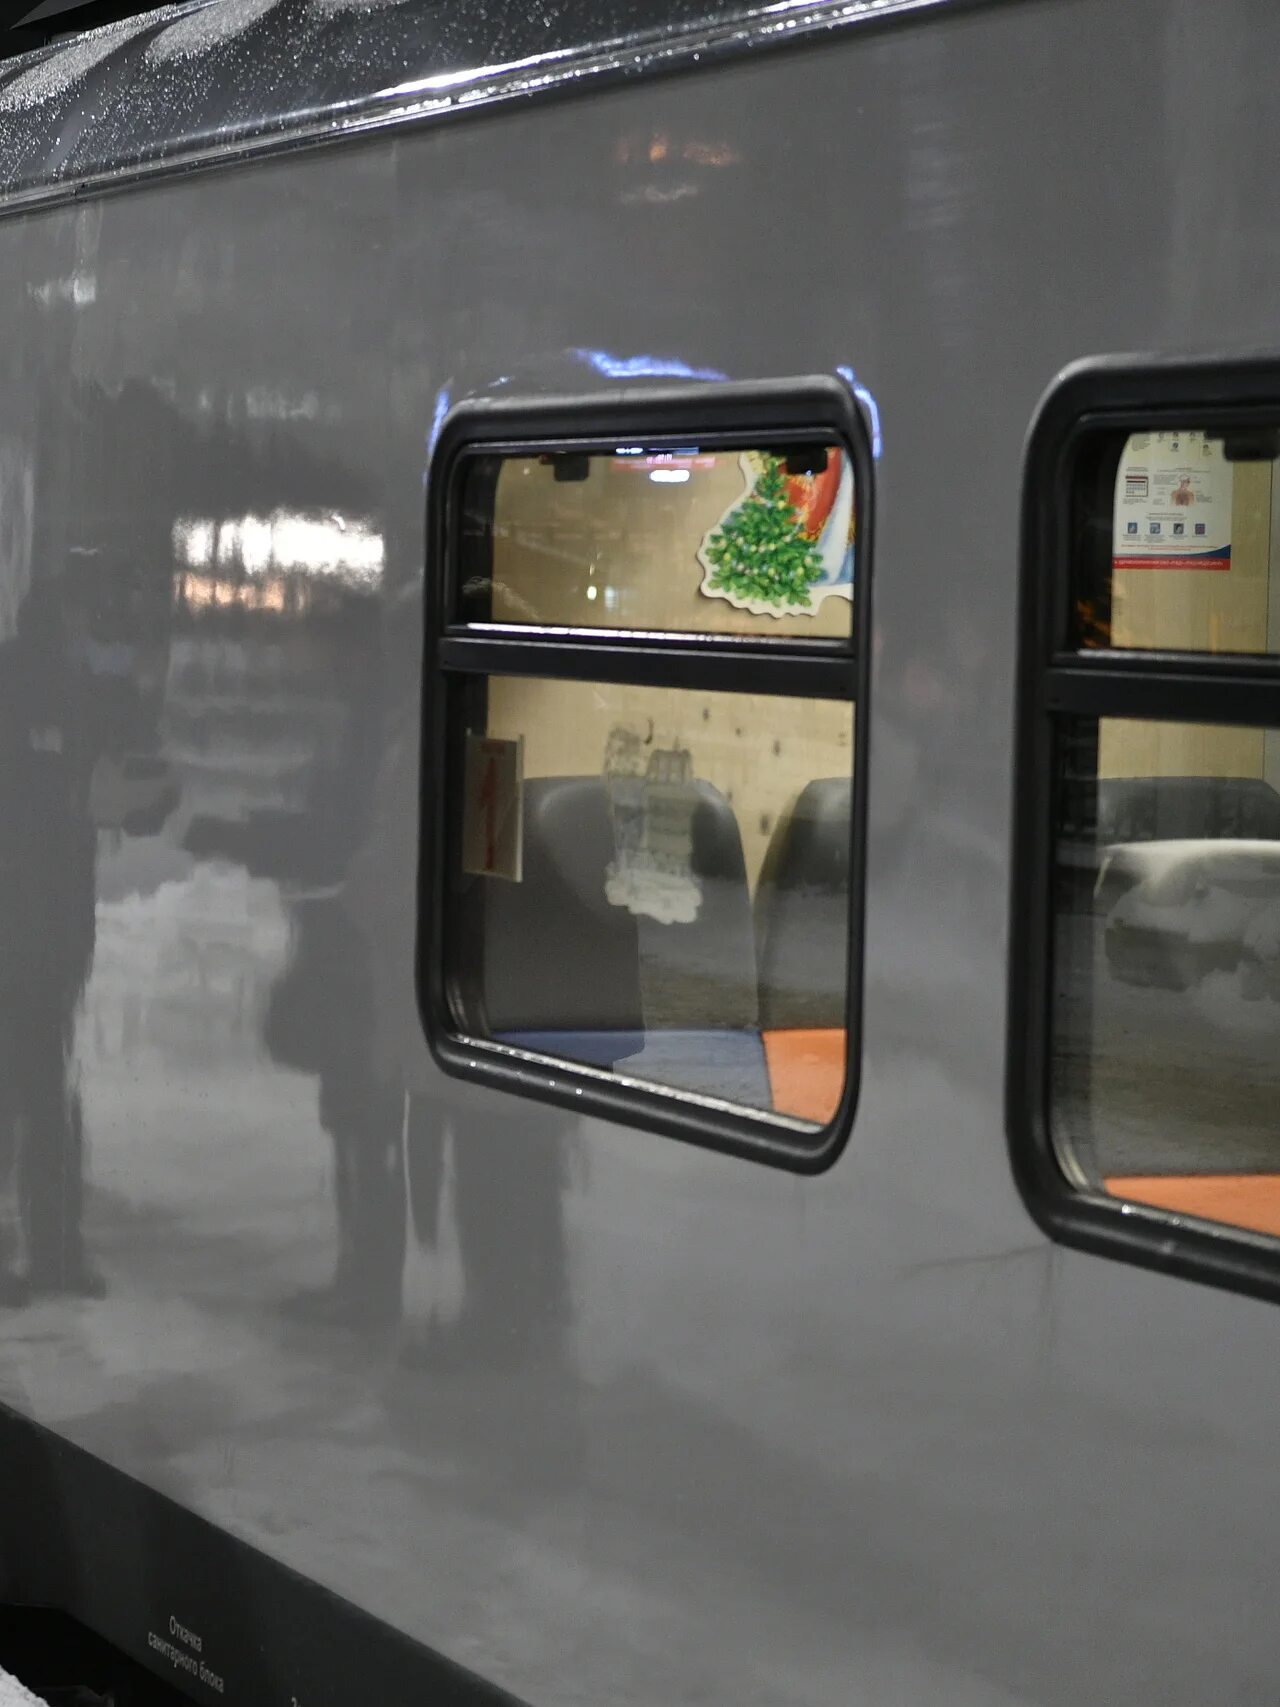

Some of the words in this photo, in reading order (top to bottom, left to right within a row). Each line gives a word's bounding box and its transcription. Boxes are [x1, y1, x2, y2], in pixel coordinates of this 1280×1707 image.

[169, 1615, 202, 1653] Откачка
[148, 1631, 198, 1676] санитарного
[199, 1660, 224, 1694] блока
